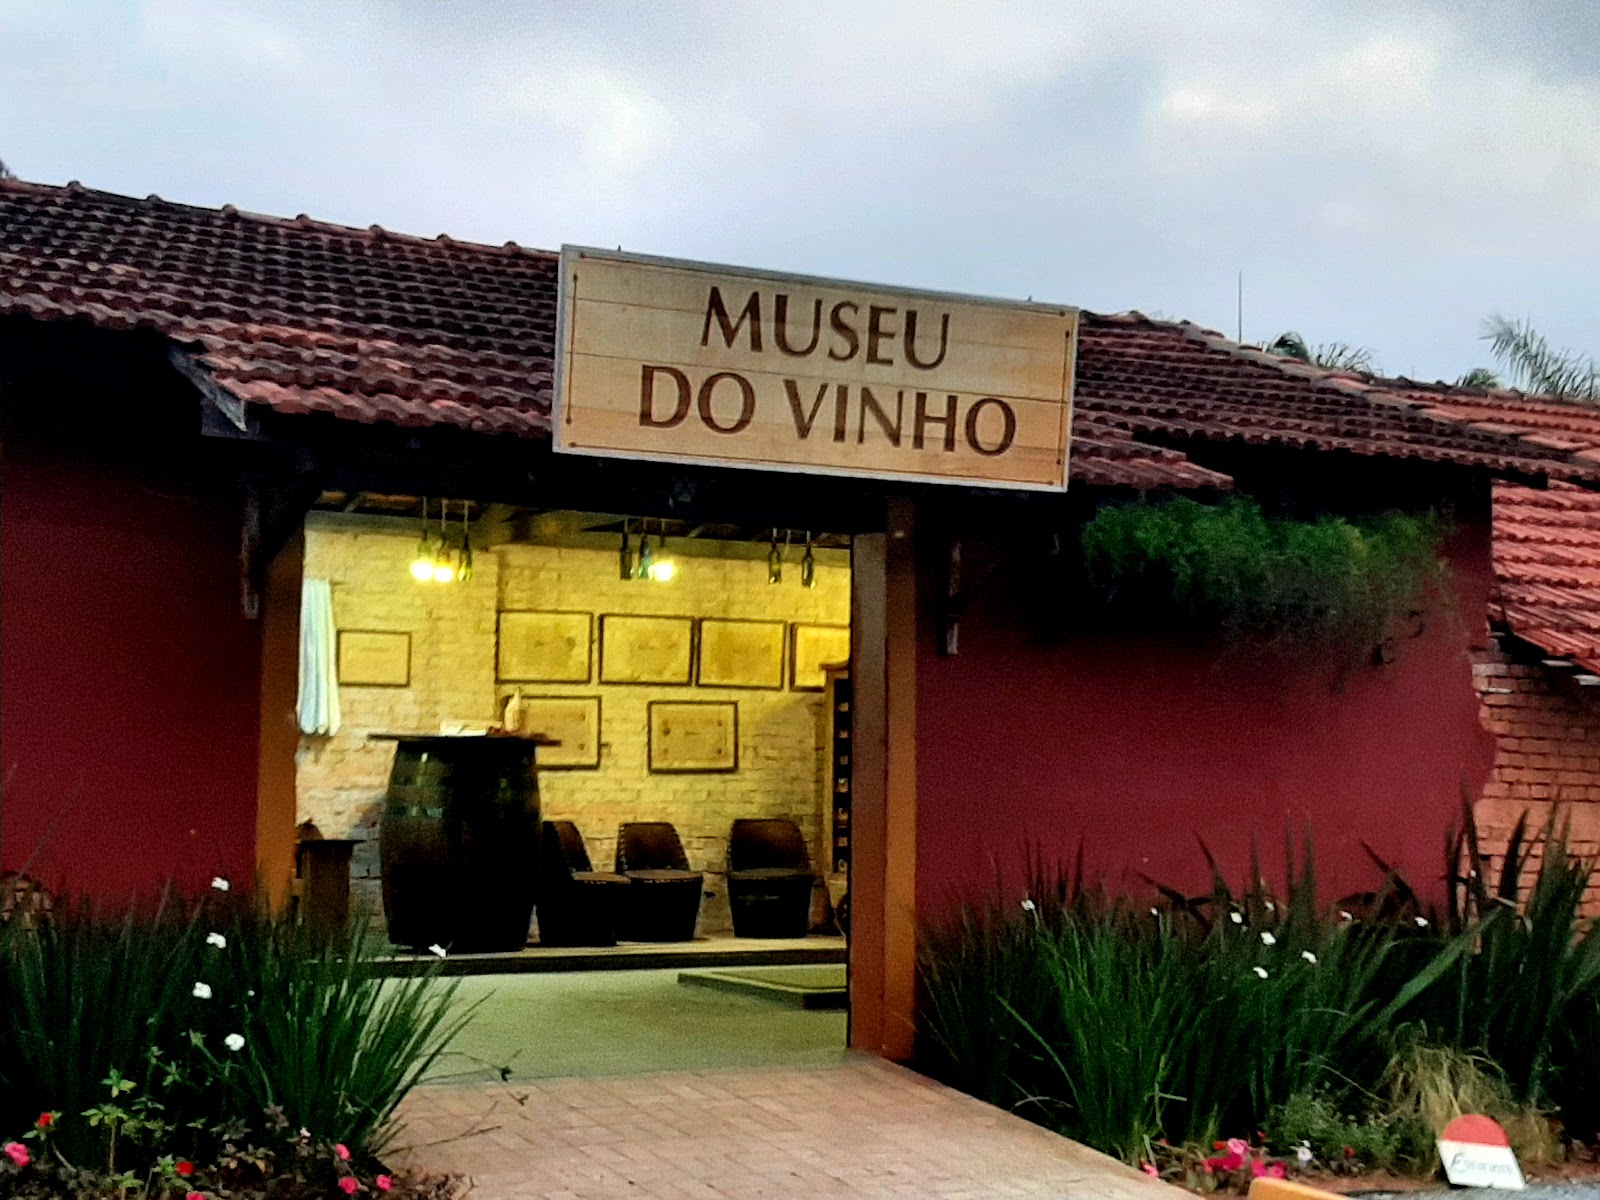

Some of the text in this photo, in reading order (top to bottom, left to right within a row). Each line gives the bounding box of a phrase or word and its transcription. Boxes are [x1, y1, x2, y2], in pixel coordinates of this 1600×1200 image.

[701, 287, 949, 370] MUSEU
[639, 364, 1017, 456] DO VINHO
